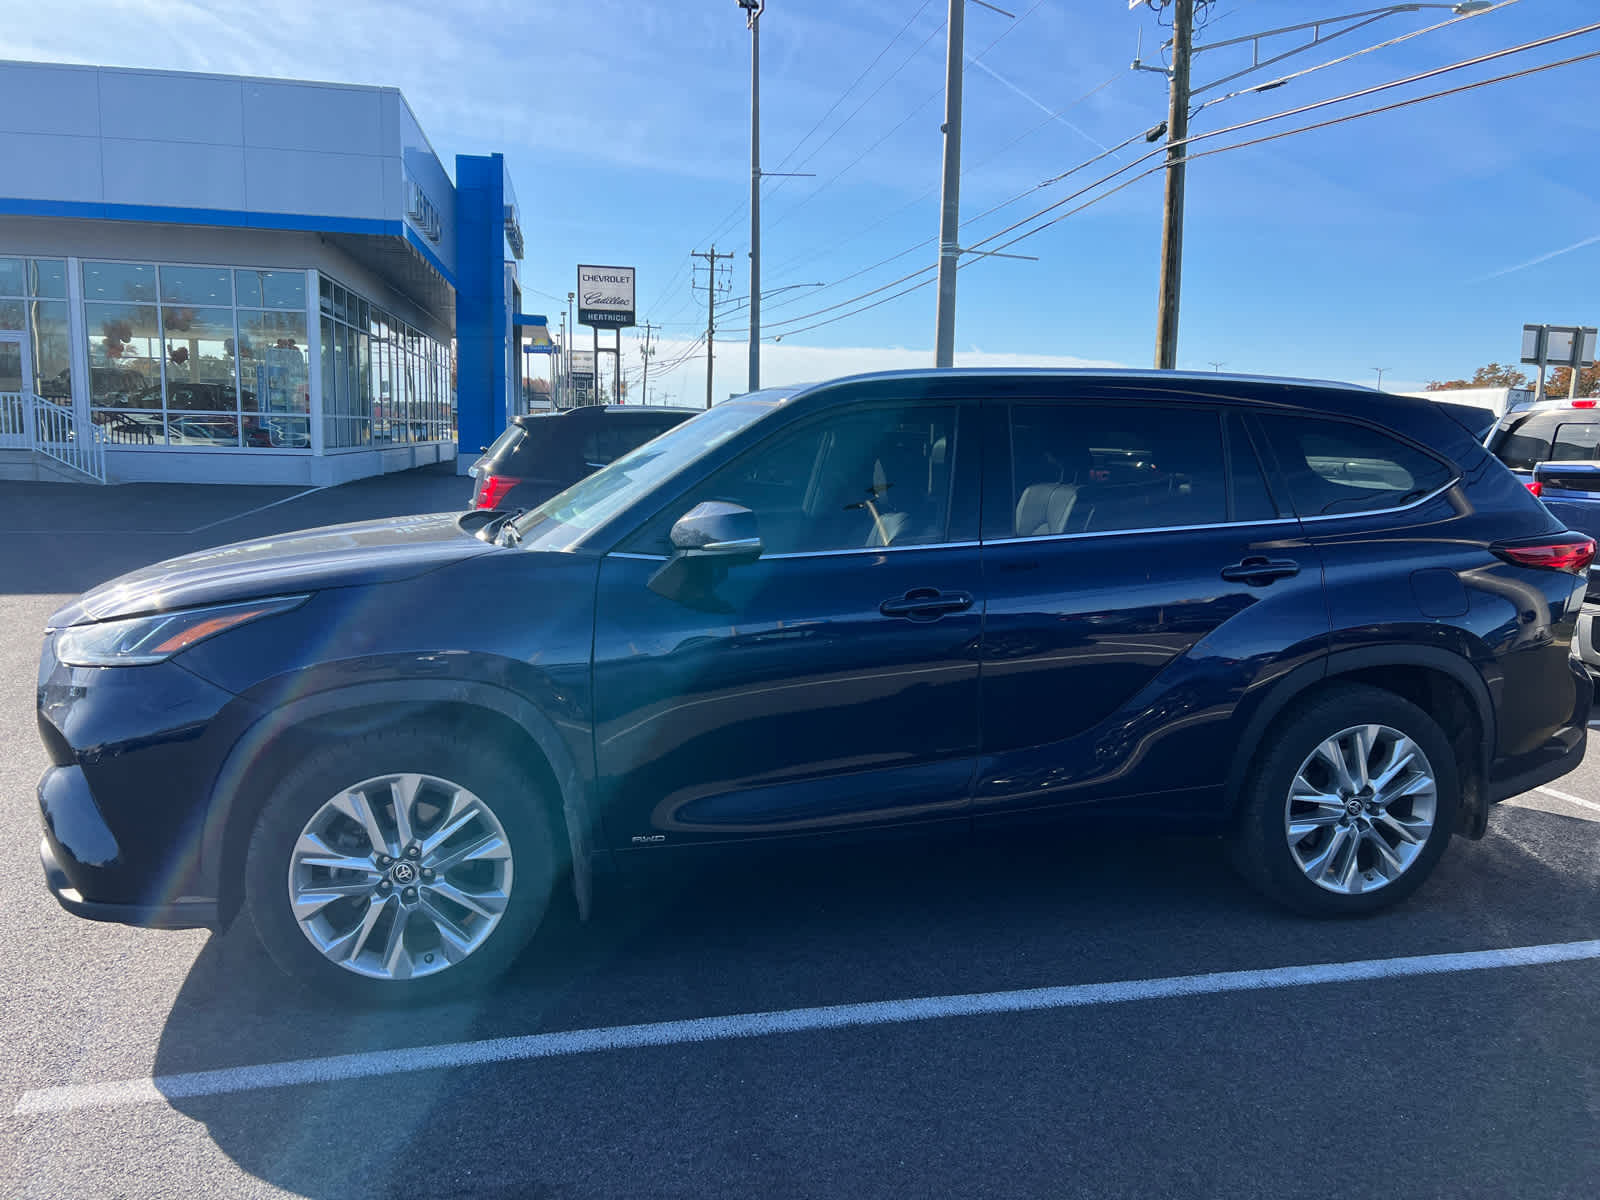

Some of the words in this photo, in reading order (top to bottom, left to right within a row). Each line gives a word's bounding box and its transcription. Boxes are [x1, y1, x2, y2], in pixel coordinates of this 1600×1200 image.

[582, 274, 632, 284] CHEVROLET
[583, 291, 630, 306] Cadillac
[587, 312, 626, 322] HERTRICH
[631, 835, 666, 843] AWD
